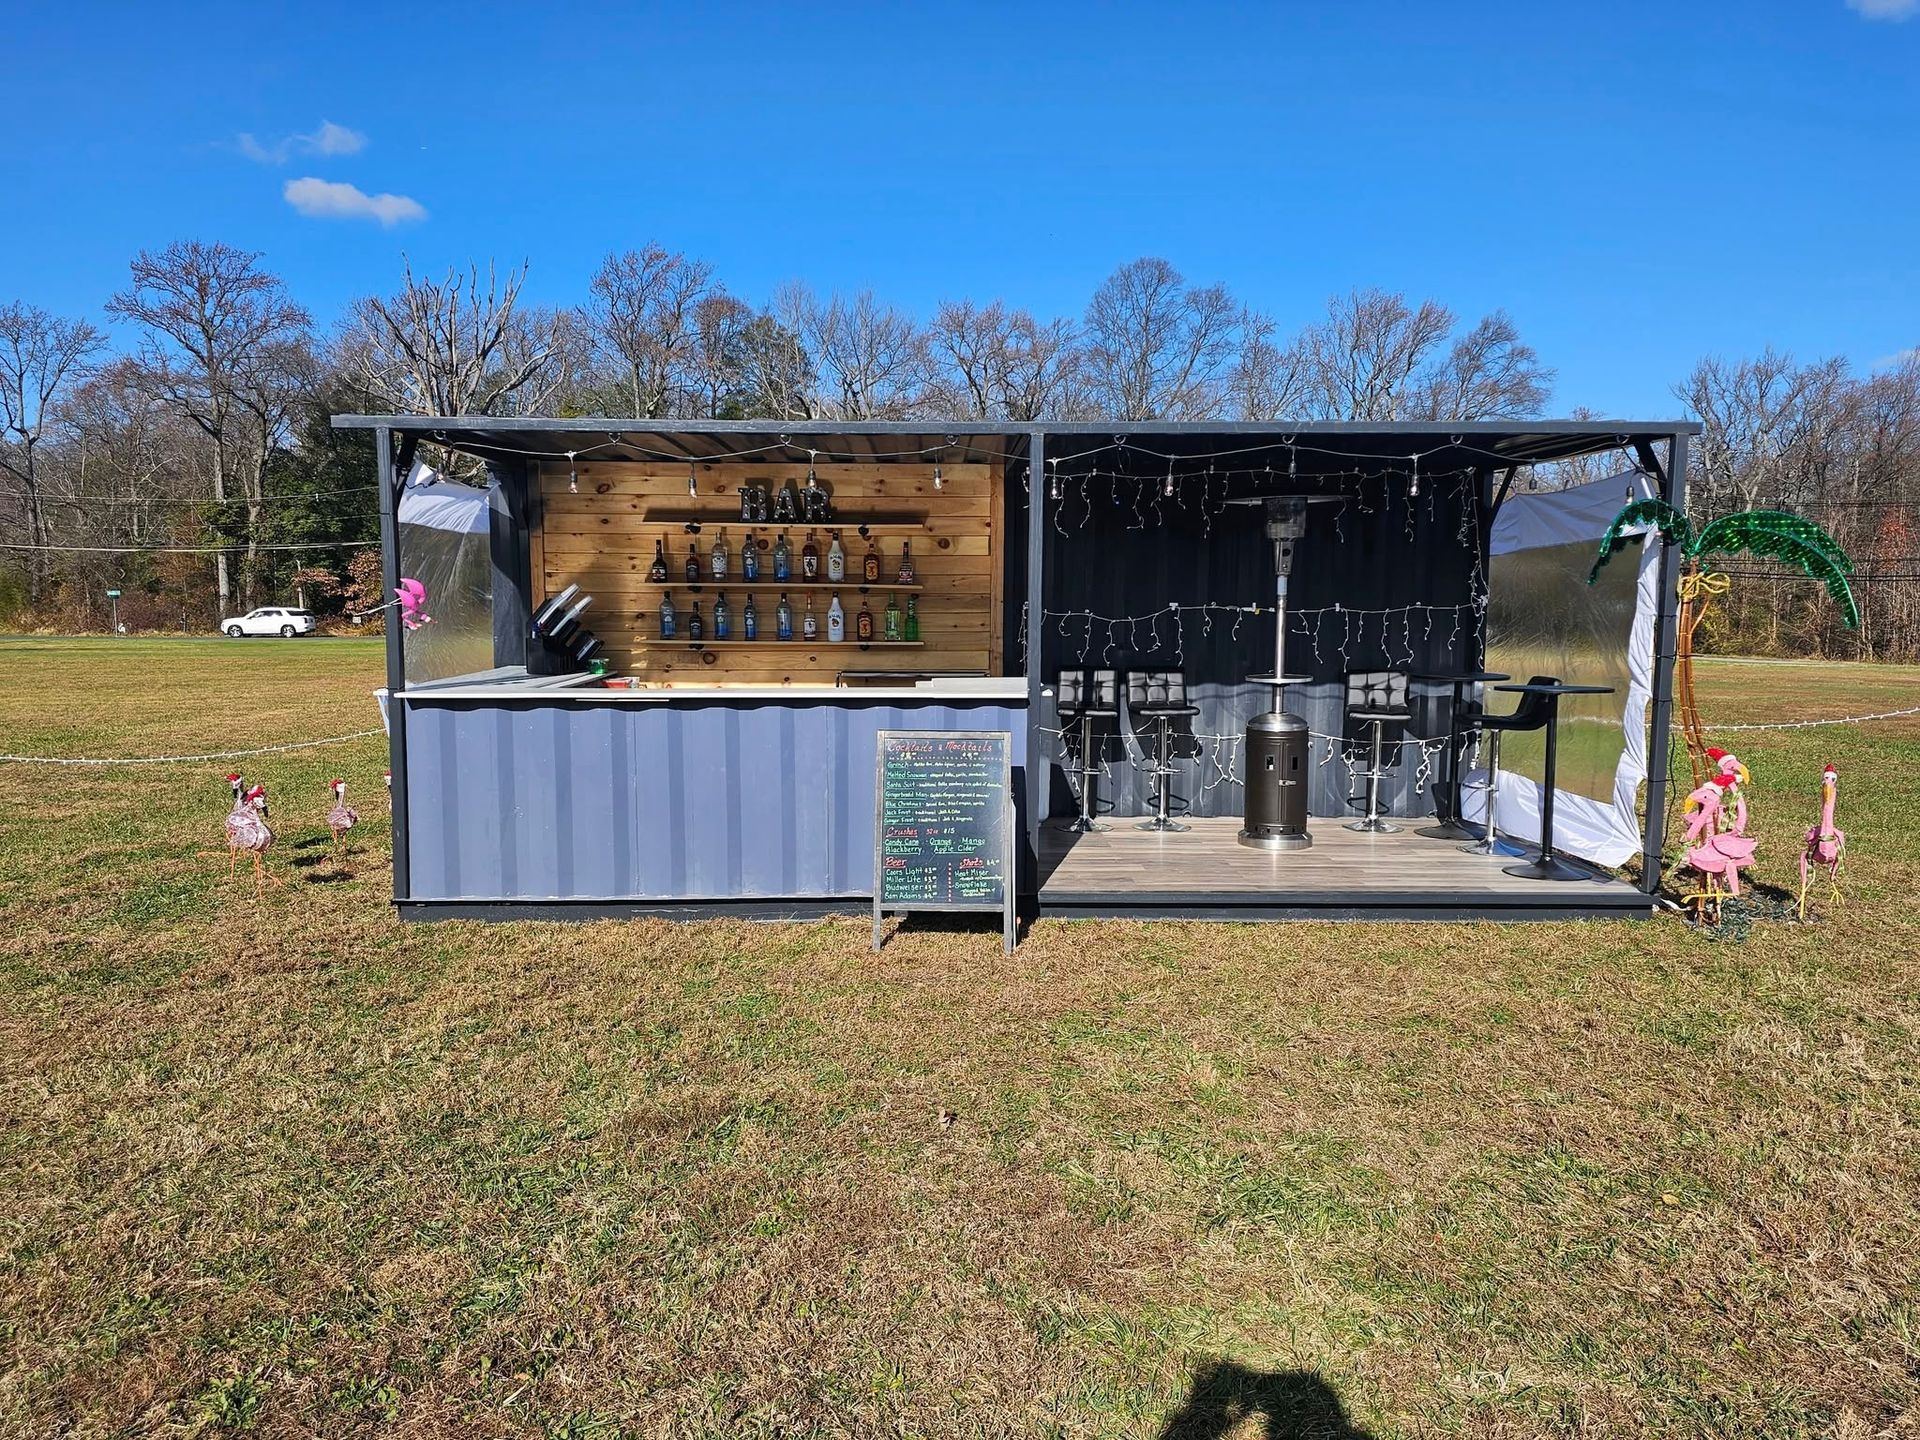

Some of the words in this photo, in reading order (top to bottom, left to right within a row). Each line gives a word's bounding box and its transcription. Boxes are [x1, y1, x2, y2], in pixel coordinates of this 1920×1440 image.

[737, 487, 832, 523] BAR
[888, 741, 932, 752] Cocktails
[946, 740, 992, 752] Mocktails
[888, 826, 918, 836] Crushes
[929, 838, 951, 846] Orange
[962, 837, 985, 846] Mango
[886, 846, 922, 855] Blackberry
[934, 845, 954, 853] Apple
[885, 857, 907, 866] Beer
[960, 857, 983, 867] Shots
